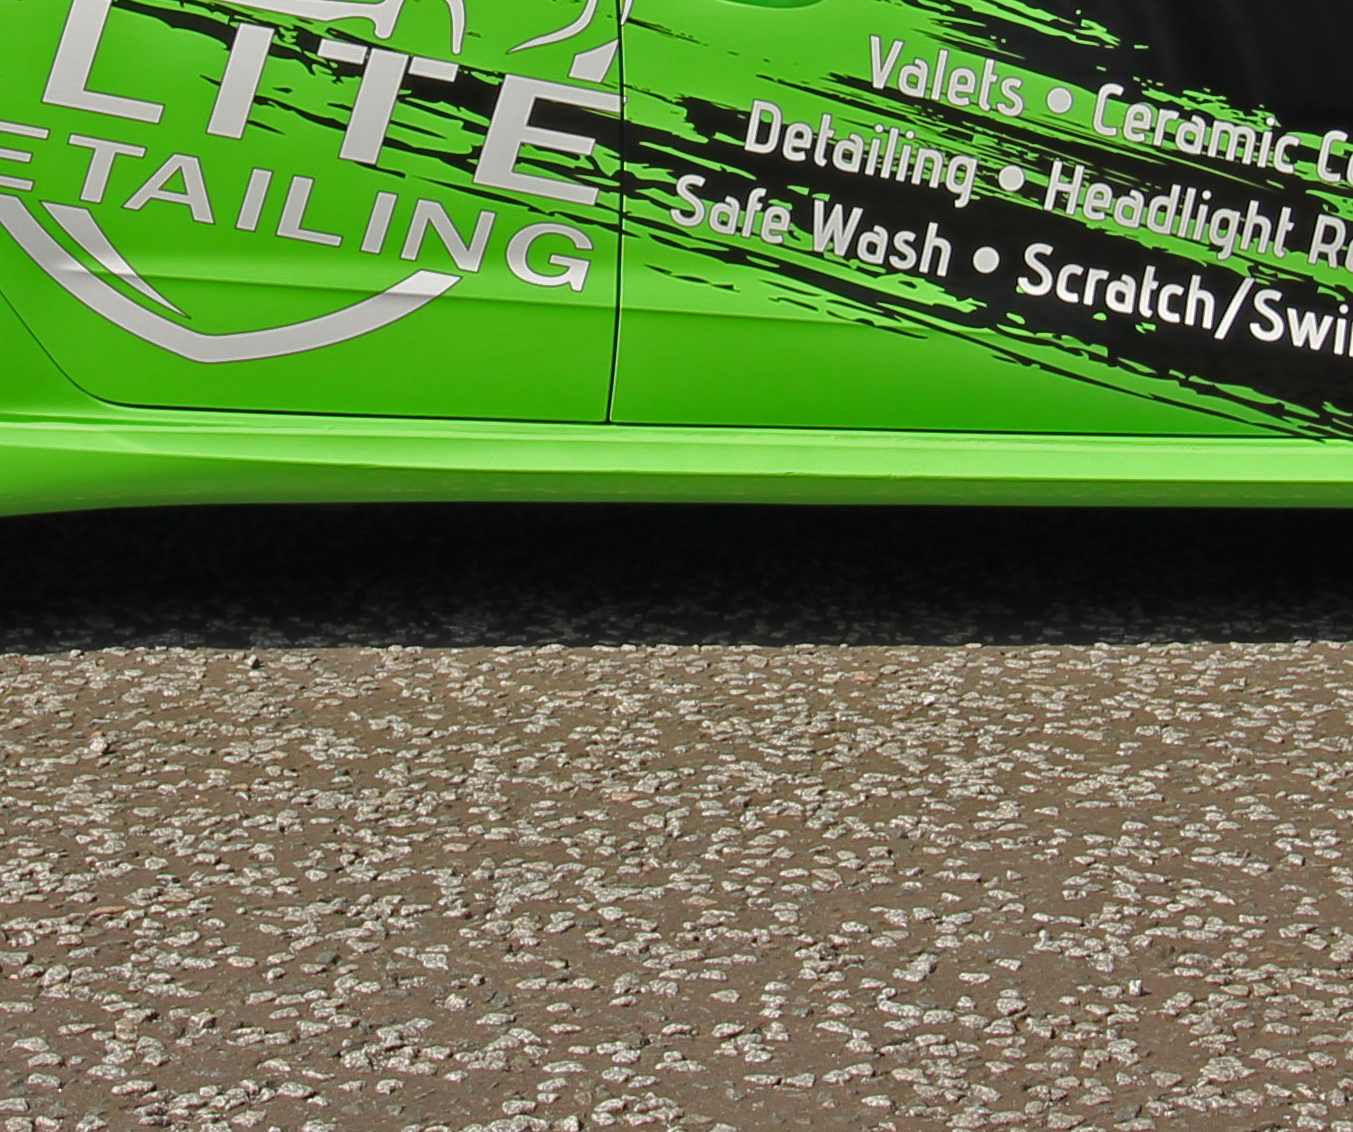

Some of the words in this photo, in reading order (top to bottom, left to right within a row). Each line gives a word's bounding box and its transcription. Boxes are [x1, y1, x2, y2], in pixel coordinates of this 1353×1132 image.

[868, 35, 1025, 117] Valets
[1092, 83, 1300, 174] Ceramic
[670, 174, 790, 244] Safe
[810, 198, 952, 278] Wash
[744, 98, 978, 208] Detailing
[1044, 161, 1295, 261] Headlight
